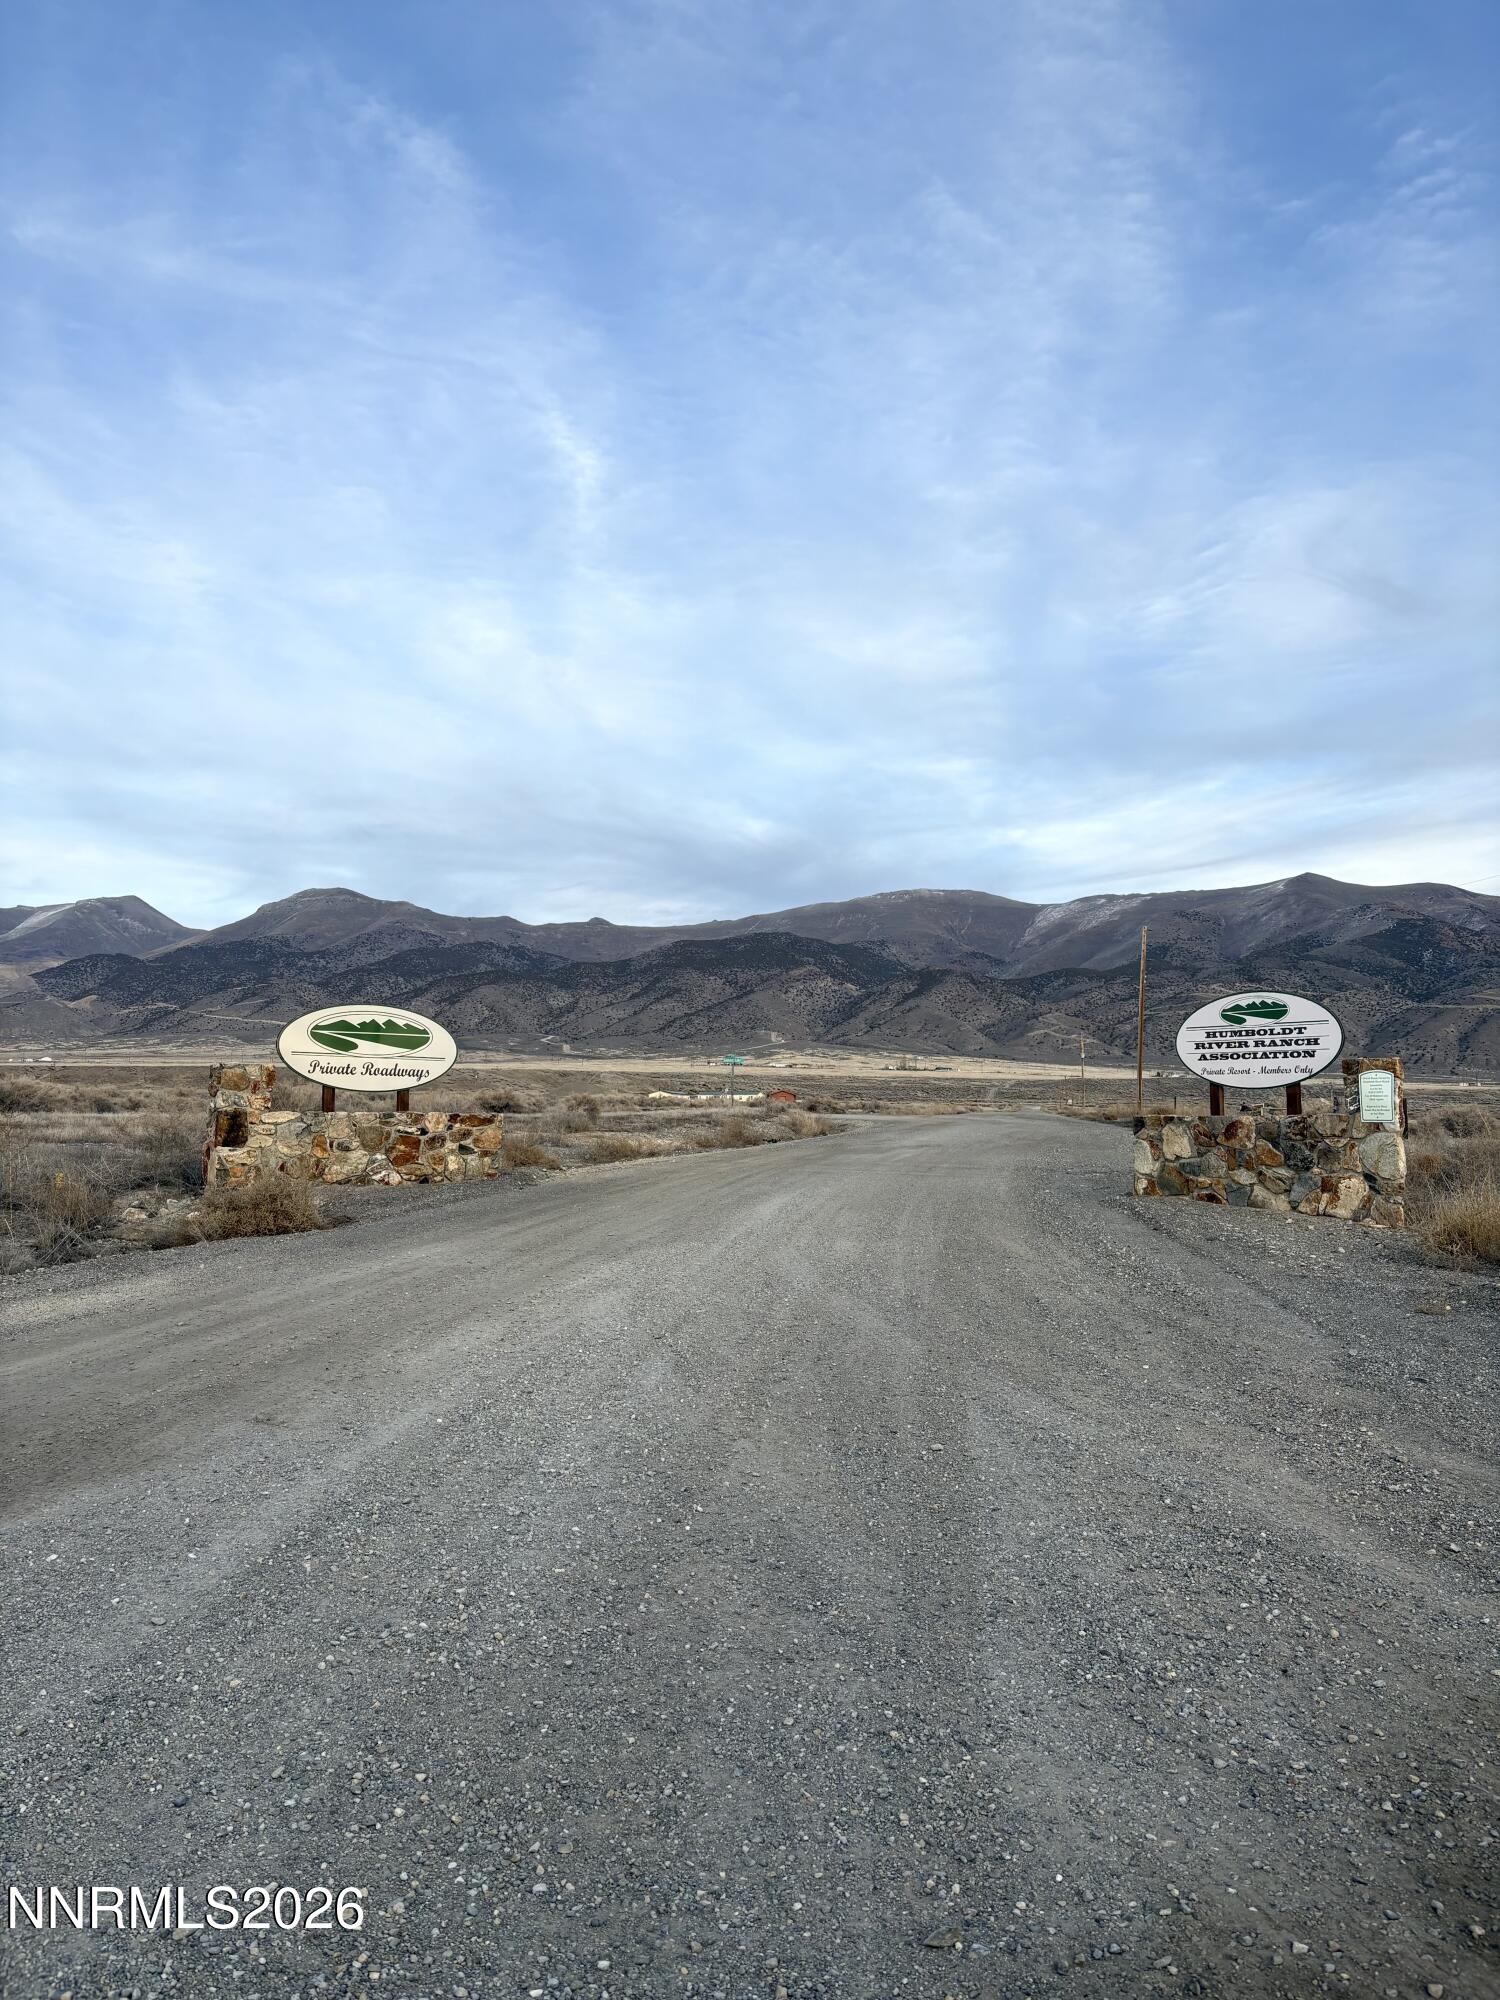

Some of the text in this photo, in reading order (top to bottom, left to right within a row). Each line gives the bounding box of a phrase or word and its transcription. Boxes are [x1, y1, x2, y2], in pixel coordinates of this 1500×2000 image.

[1204, 1027, 1307, 1039] HUMBOLDT
[1194, 1038, 1320, 1050] RIVER RANCH
[1198, 1050, 1316, 1061] ASSOCIATION
[308, 1060, 430, 1082] Private Roadways
[1200, 1067, 1225, 1075] Private
[1227, 1066, 1251, 1075] Resort
[1258, 1066, 1292, 1074] Members
[1294, 1065, 1313, 1076] Only
